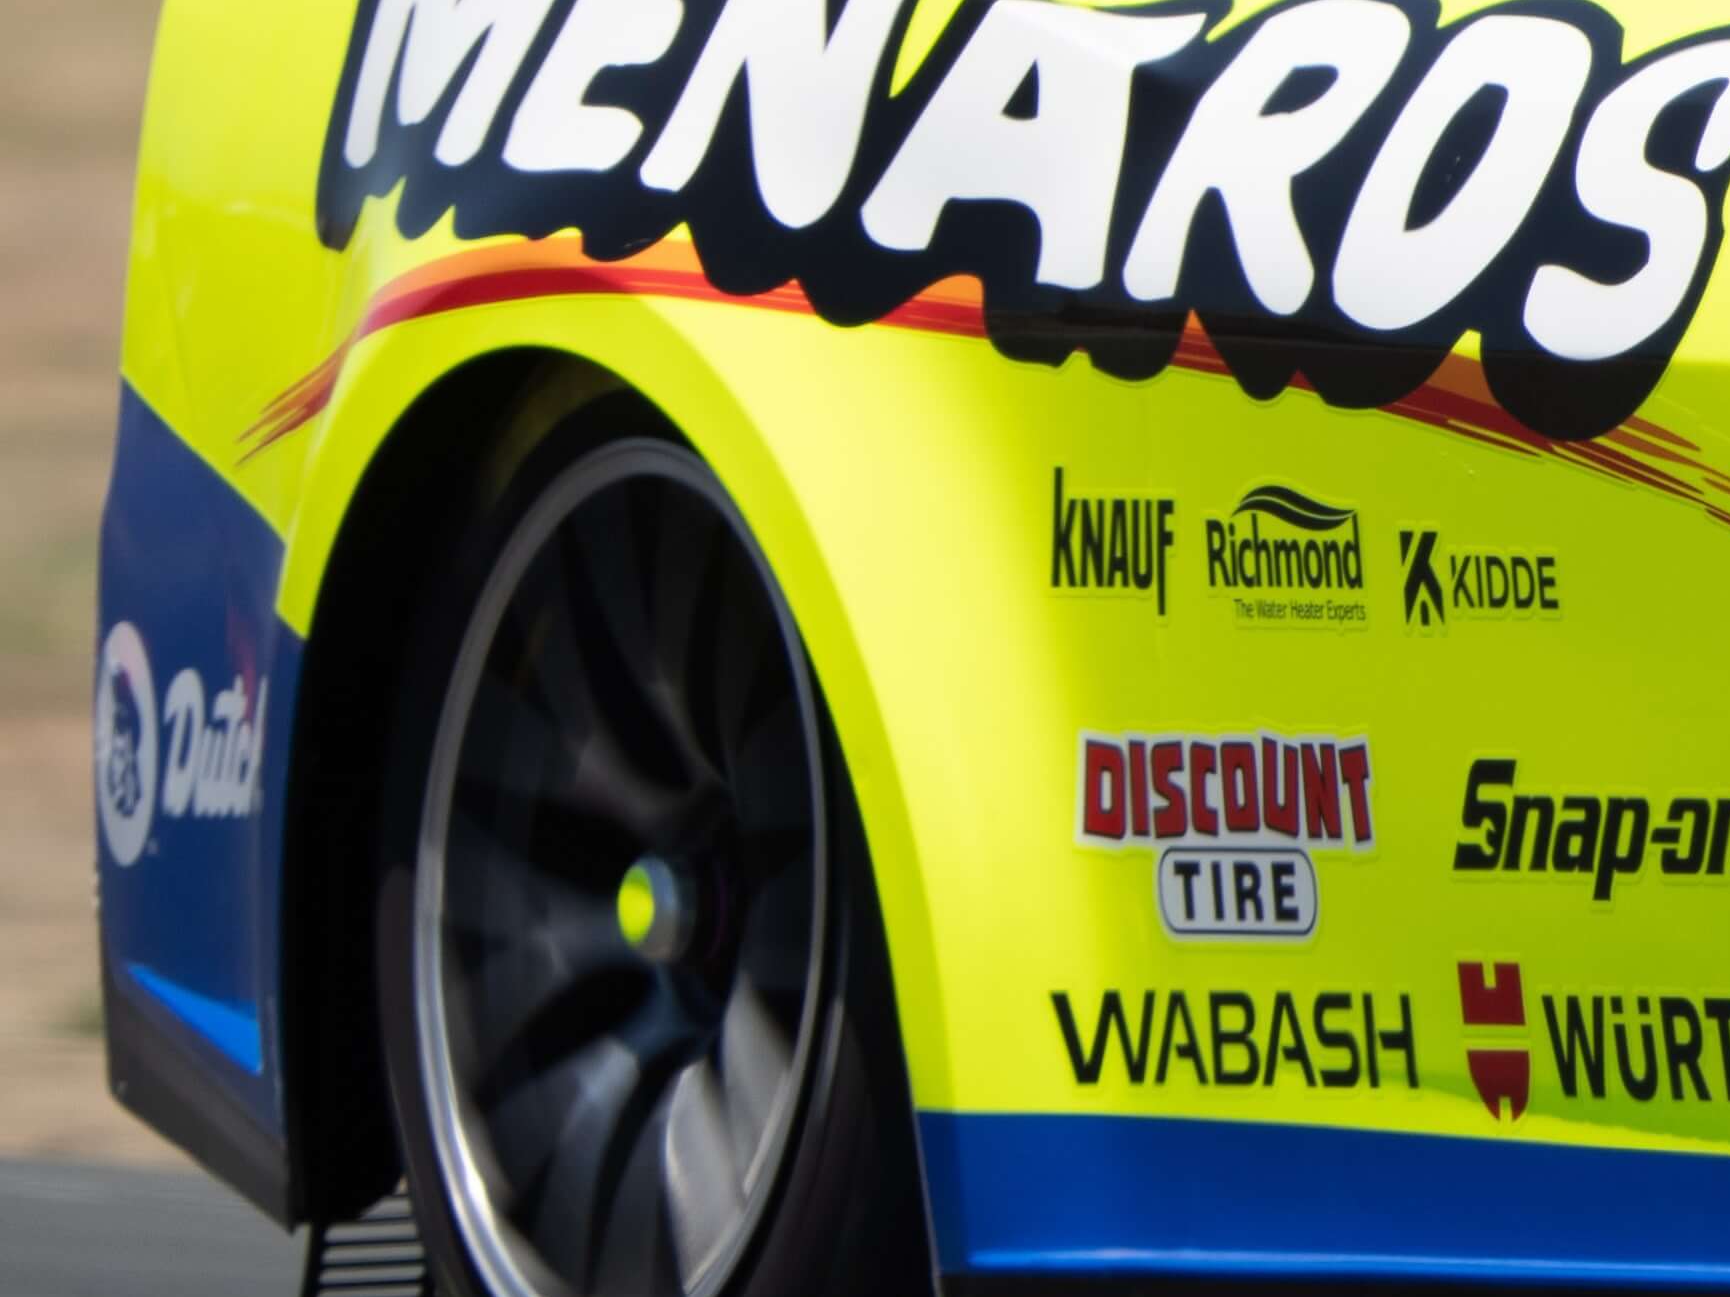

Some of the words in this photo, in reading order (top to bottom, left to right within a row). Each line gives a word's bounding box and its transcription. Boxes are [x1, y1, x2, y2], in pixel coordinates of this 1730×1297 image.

[1050, 466, 1175, 617] KNAUF
[1205, 512, 1364, 590] Richmond
[1450, 553, 1559, 611] KIDDE
[1081, 735, 1371, 845] DISCOUNT
[1172, 860, 1301, 923] TIRE
[1049, 989, 1421, 1090] WABASH
